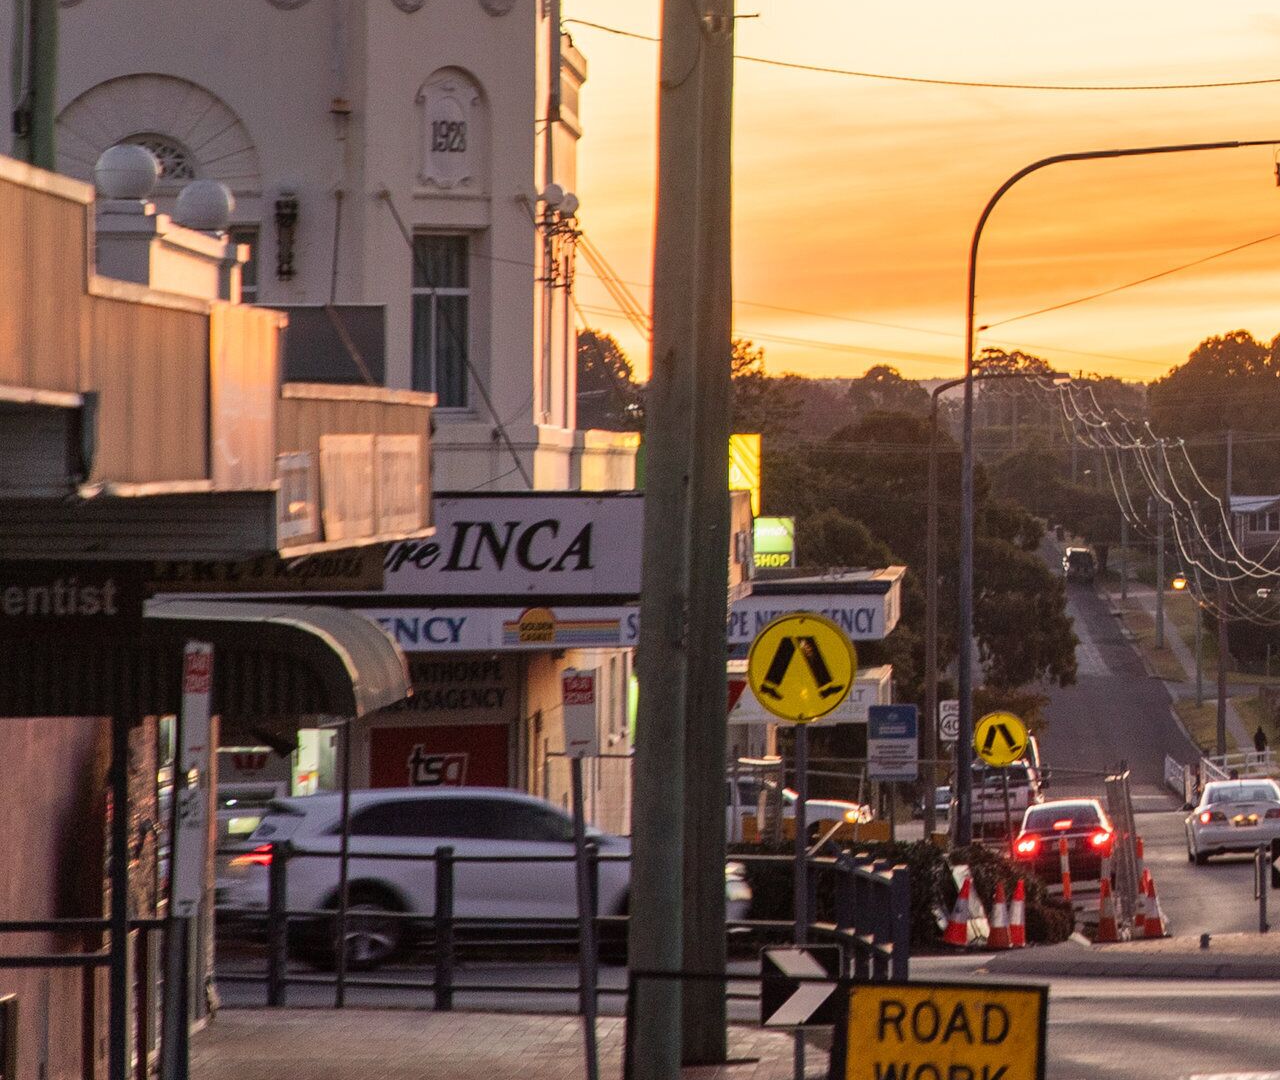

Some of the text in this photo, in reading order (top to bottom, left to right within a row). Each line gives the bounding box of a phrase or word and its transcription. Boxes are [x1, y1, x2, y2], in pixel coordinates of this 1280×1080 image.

[440, 519, 596, 571] INCA
[754, 554, 790, 567] SHOP
[877, 1000, 1011, 1045] ROAD
